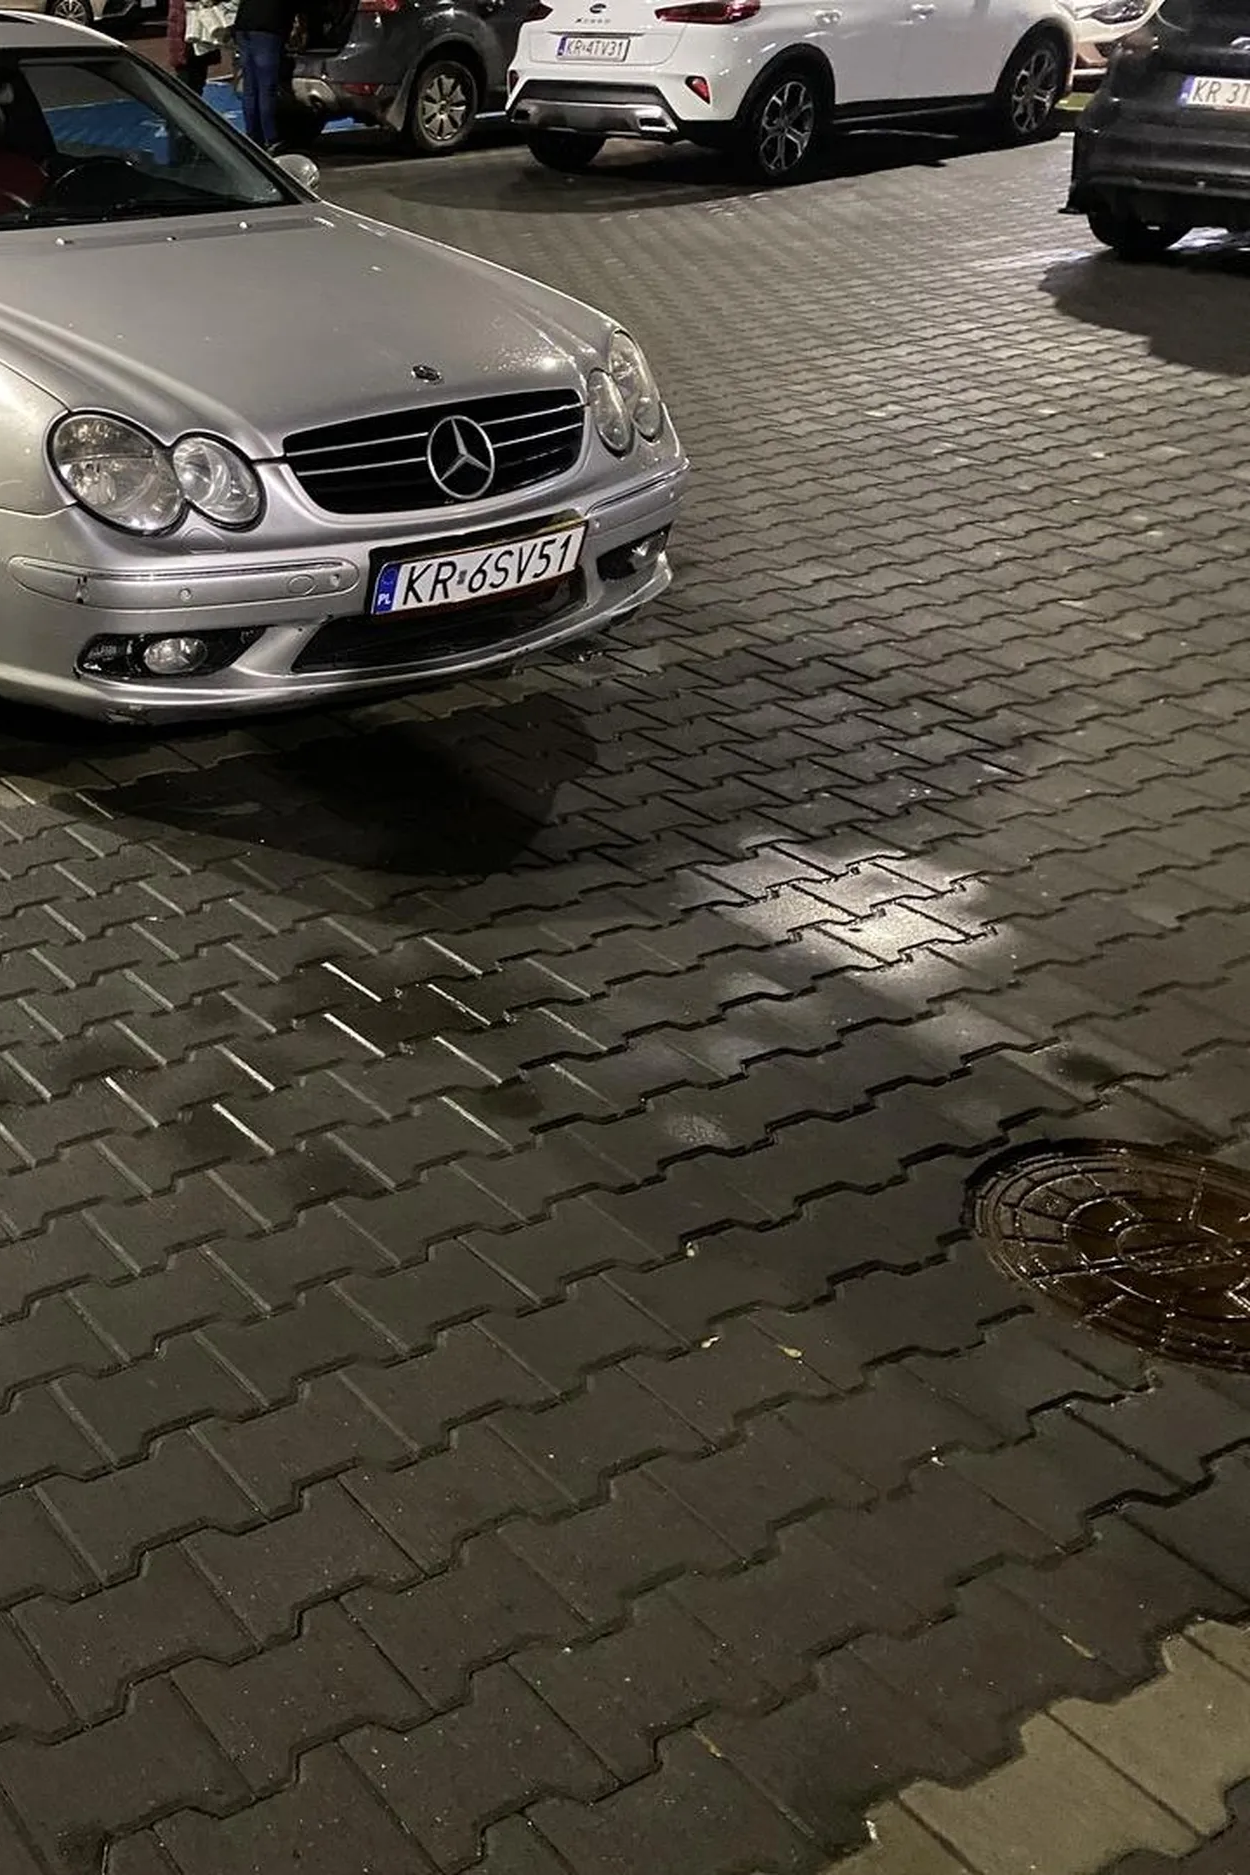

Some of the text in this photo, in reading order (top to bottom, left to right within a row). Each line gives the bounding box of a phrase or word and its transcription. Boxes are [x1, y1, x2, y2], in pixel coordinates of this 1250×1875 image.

[1192, 80, 1222, 102] KR
[402, 534, 573, 606] KR 6SV51
[377, 592, 392, 606] PL
